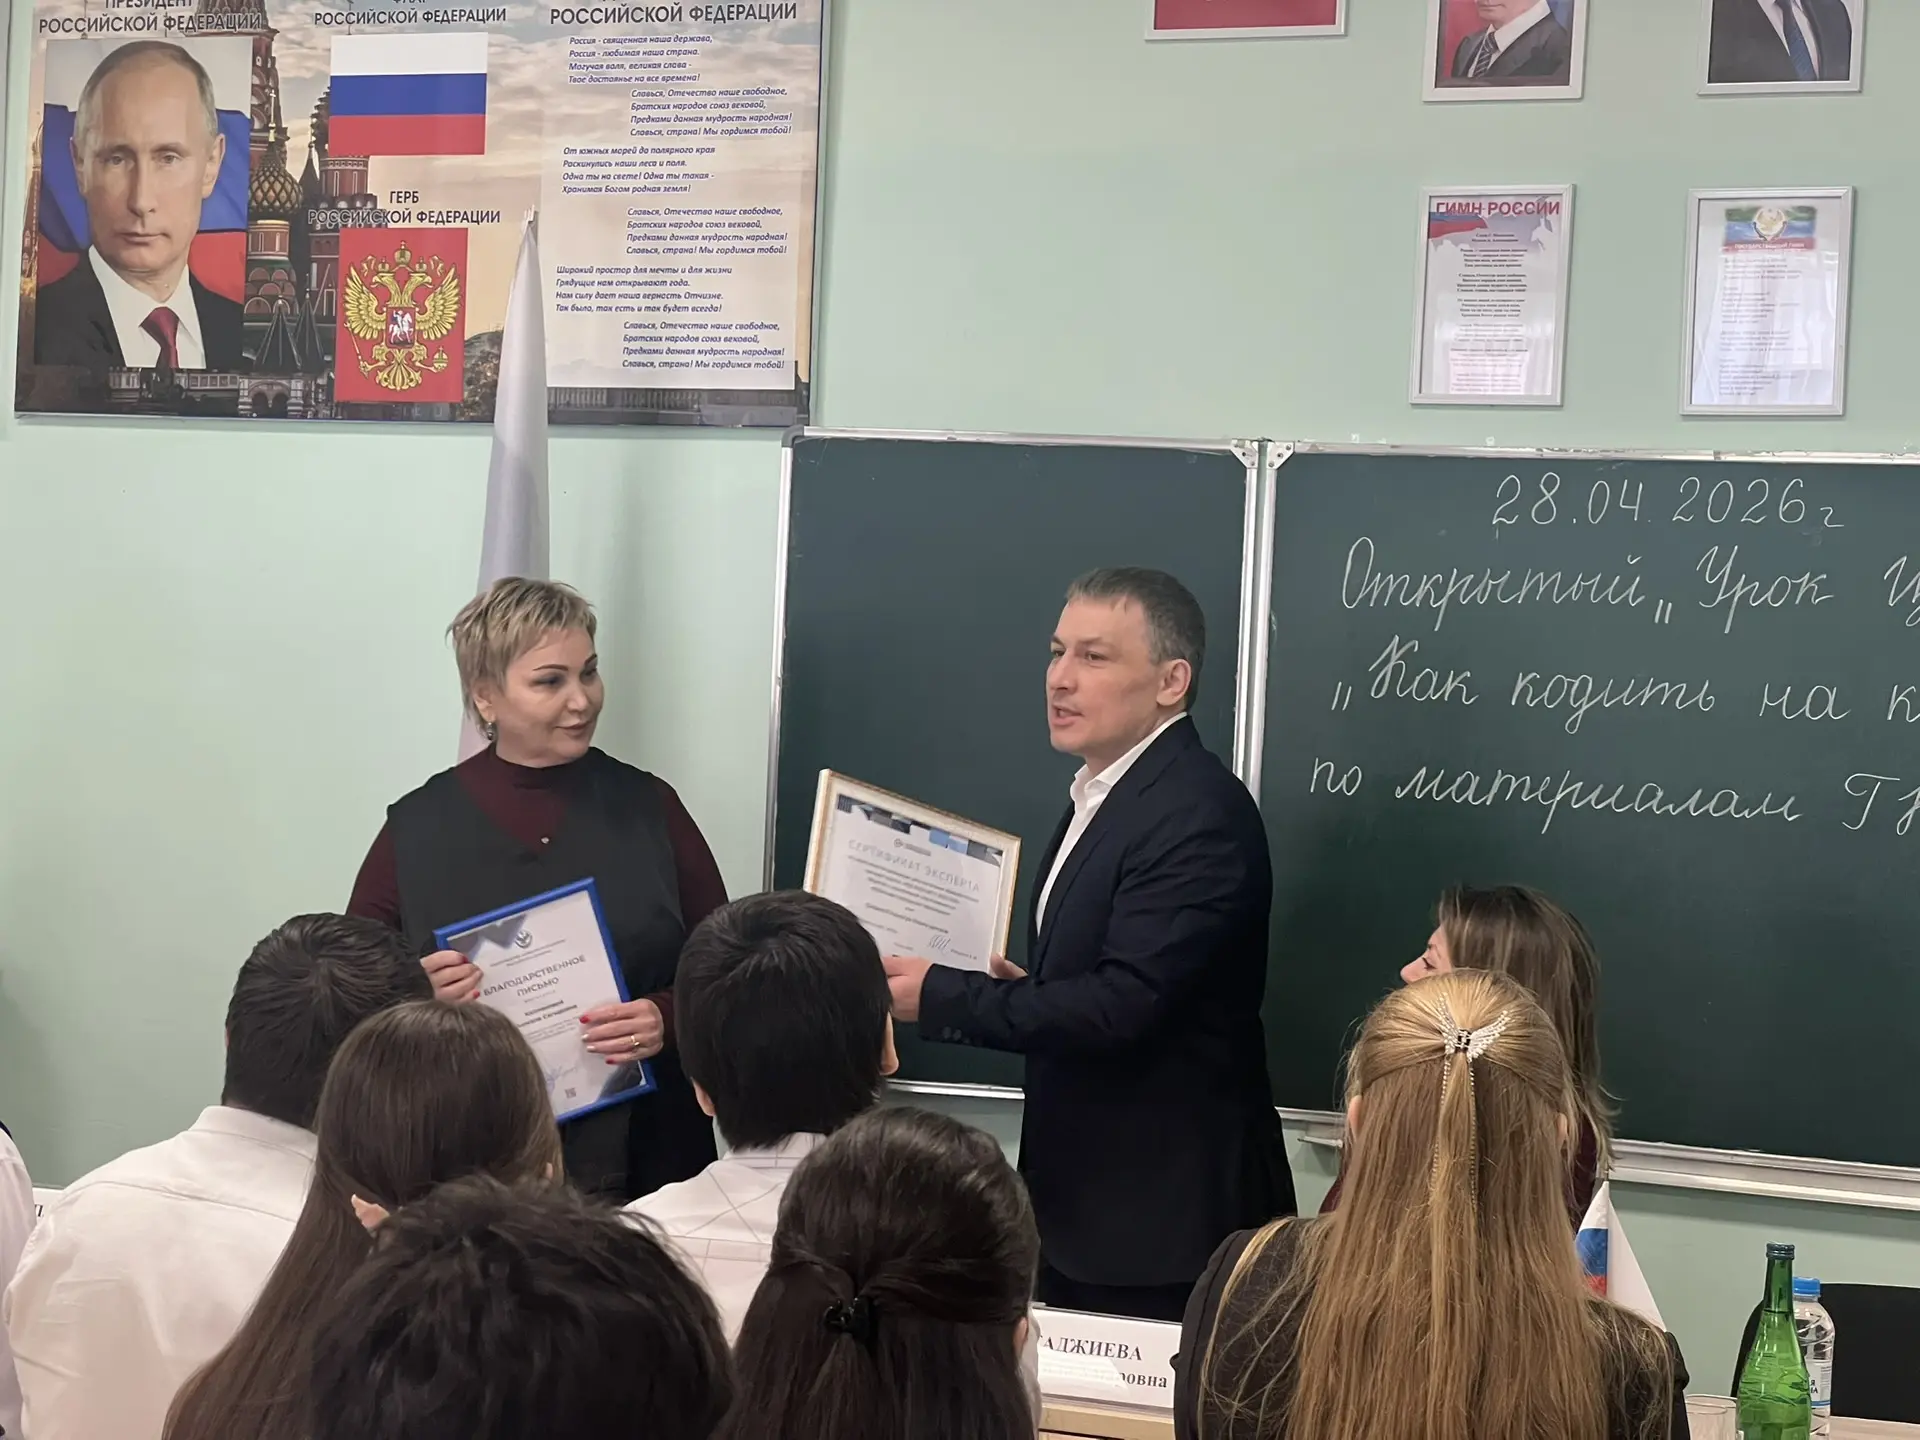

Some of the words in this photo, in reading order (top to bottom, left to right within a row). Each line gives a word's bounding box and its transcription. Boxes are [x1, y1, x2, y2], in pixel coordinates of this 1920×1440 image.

[315, 8, 417, 25] РОССИЙСКОЙ
[422, 8, 507, 24] ФЕДЕРАЦИИ
[550, 2, 683, 24] РОССИЙСКОЙ
[689, 3, 797, 24] ФЕДЕРАЦИИ
[39, 13, 158, 33] РОССИЙСКОЙ
[163, 13, 261, 33] ФЕДЕРАЦИИ
[568, 37, 596, 45] Россия
[601, 38, 648, 46] священная
[672, 35, 713, 44] держава,
[568, 50, 596, 58] Россия
[602, 49, 640, 57] любимая
[568, 62, 604, 72] Могучая
[628, 62, 662, 70] великая
[660, 74, 700, 83] времена!
[630, 89, 667, 98] Славься,
[666, 88, 717, 97] Отечество
[741, 87, 788, 96] свободное,
[630, 102, 671, 112] Братских
[671, 102, 708, 111] народов
[730, 101, 766, 110] вековой,
[630, 115, 672, 125] Предками
[672, 115, 703, 123] данная
[704, 114, 747, 124] мудрость
[748, 113, 793, 123] народная!
[629, 128, 665, 137] Славься,
[665, 128, 701, 137] страна!
[719, 126, 759, 136] гордимся
[759, 126, 791, 134] тобой!
[610, 147, 637, 156] морей
[649, 148, 693, 156] полярного
[562, 160, 613, 169] Раскинулись
[612, 172, 642, 180] свете!
[562, 185, 603, 194] Хранимая
[631, 185, 661, 194] родная
[390, 191, 420, 204] ГЕРБ
[626, 208, 663, 216] Славься,
[738, 208, 783, 216] свободное,
[1436, 201, 1482, 215] ГИМН
[1487, 201, 1560, 215] РОССИИ
[308, 207, 412, 224] РОССИЙСКОЙ
[416, 209, 501, 225] ФЕДЕРАЦИИ
[626, 221, 667, 230] Братских
[668, 221, 703, 230] народов
[727, 221, 763, 229] вековой,
[626, 234, 668, 242] Предками
[700, 234, 744, 242] мудрость
[744, 234, 788, 242] народная!
[625, 246, 661, 255] Славься,
[661, 246, 697, 255] страна!
[715, 246, 755, 255] гордимся
[756, 246, 787, 254] тобой!
[556, 266, 594, 275] Широкий
[555, 278, 595, 288] Грядущие
[668, 279, 690, 287] года.
[683, 292, 723, 300] Отчизне.
[570, 304, 594, 312] было,
[662, 304, 689, 313] будет
[690, 304, 722, 312] всегда!
[623, 321, 659, 330] Славься,
[734, 322, 780, 331] свободное,
[622, 334, 663, 344] Братских
[664, 335, 700, 344] народов
[722, 335, 760, 344] вековой,
[622, 347, 664, 356] Предками
[664, 347, 695, 355] данная
[696, 348, 740, 357] мудрость
[741, 348, 784, 357] народная!
[621, 360, 657, 368] Славься,
[657, 360, 693, 369] страна!
[711, 360, 752, 369] гордимся
[753, 360, 784, 368] тобой!
[1511, 672, 1715, 734] кодить
[1758, 683, 1851, 721] на
[1309, 757, 1362, 796] по
[1395, 767, 1803, 834] материалам
[483, 954, 587, 997] БЛАГОДАРСТВЕННОЕ
[516, 976, 560, 997] ПИСЬМО
[1039, 1333, 1142, 1361] АДЖИЕВА
